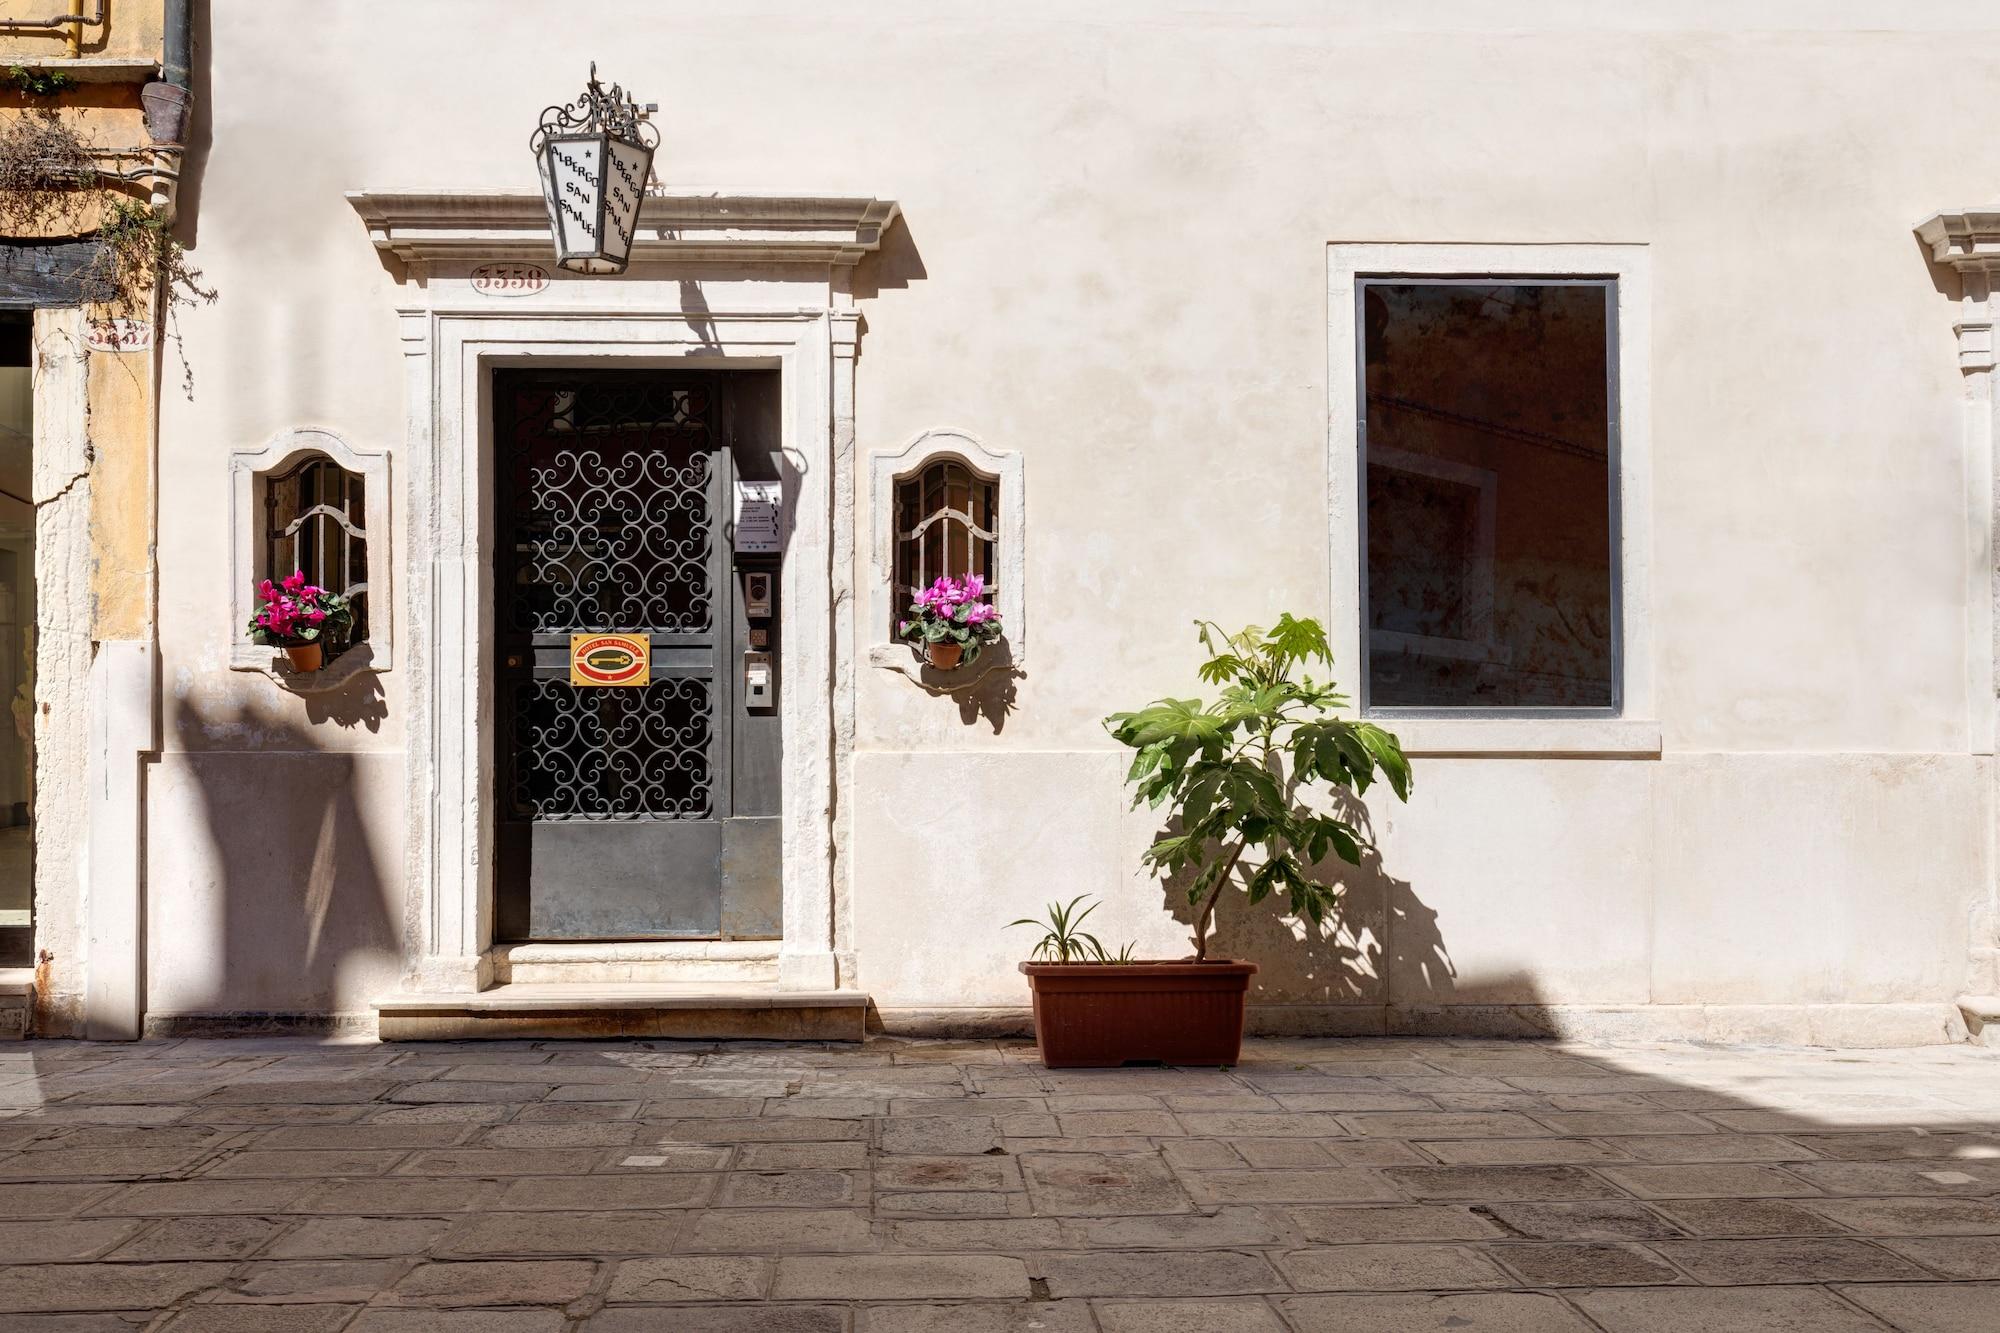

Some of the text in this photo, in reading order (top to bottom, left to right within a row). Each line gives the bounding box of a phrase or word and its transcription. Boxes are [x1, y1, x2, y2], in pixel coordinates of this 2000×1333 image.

[551, 146, 598, 187] ALBERGO
[608, 147, 640, 199] ALBERGO
[566, 182, 590, 204] SAN
[613, 187, 631, 214] SAN
[476, 268, 543, 290] 3358
[580, 643, 600, 655] HOTEL
[613, 640, 640, 654] SAMUELE
